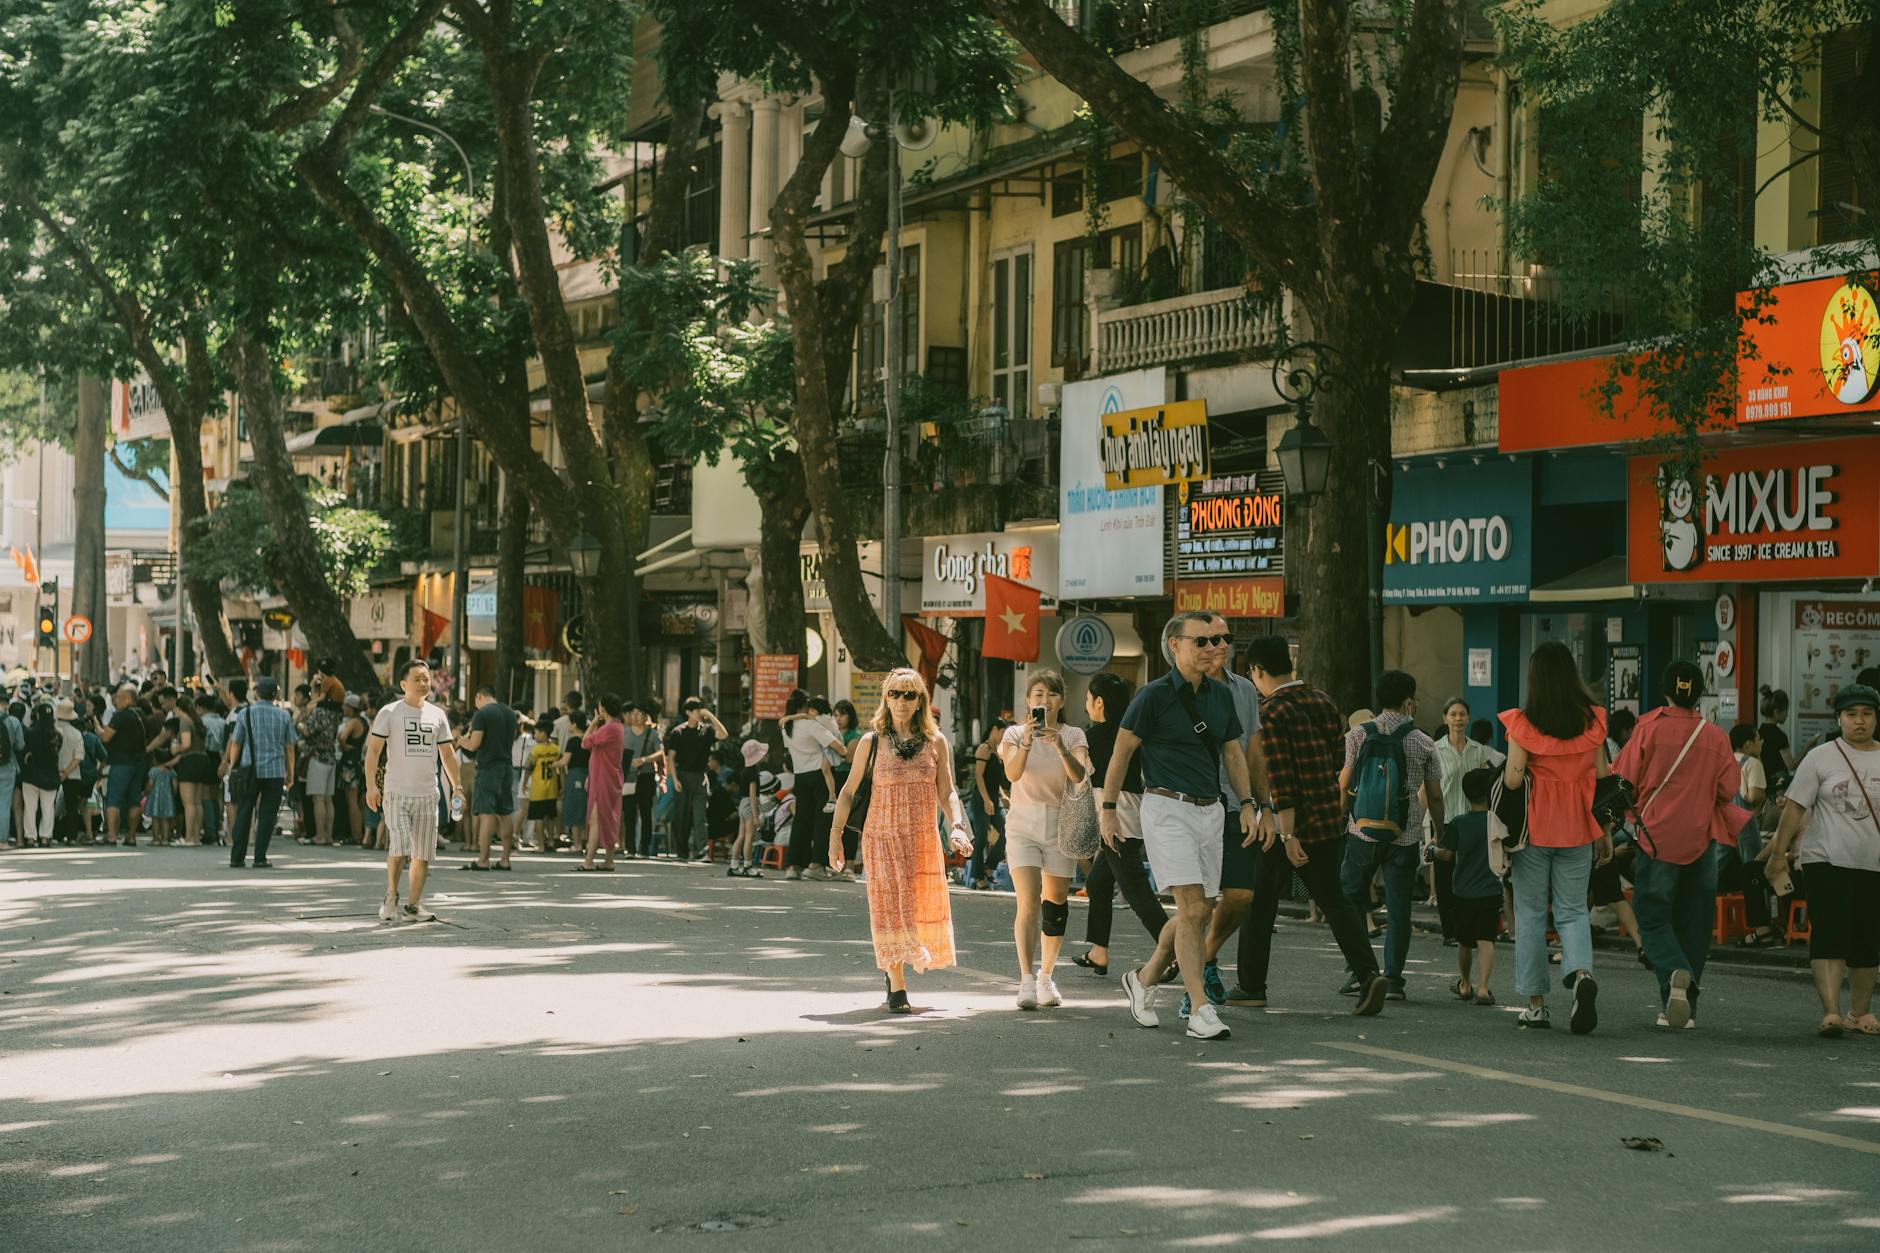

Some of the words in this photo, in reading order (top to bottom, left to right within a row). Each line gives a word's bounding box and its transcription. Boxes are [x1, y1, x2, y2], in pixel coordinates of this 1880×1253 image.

[1773, 385, 1789, 400] KHAY
[1780, 401, 1792, 416] 151
[1243, 488, 1280, 528] ĐÔNG
[1705, 465, 1834, 535] MIXUE
[1708, 544, 1731, 561] SINCE
[1758, 543, 1772, 559] ICE
[1775, 541, 1805, 559] CREAM
[1807, 541, 1815, 557] &
[1816, 540, 1835, 558] TEA
[934, 544, 975, 594] Gong
[977, 541, 1008, 579] cha
[1252, 586, 1280, 615] Ngay
[405, 721, 434, 733] JG
[407, 734, 432, 746] BL
